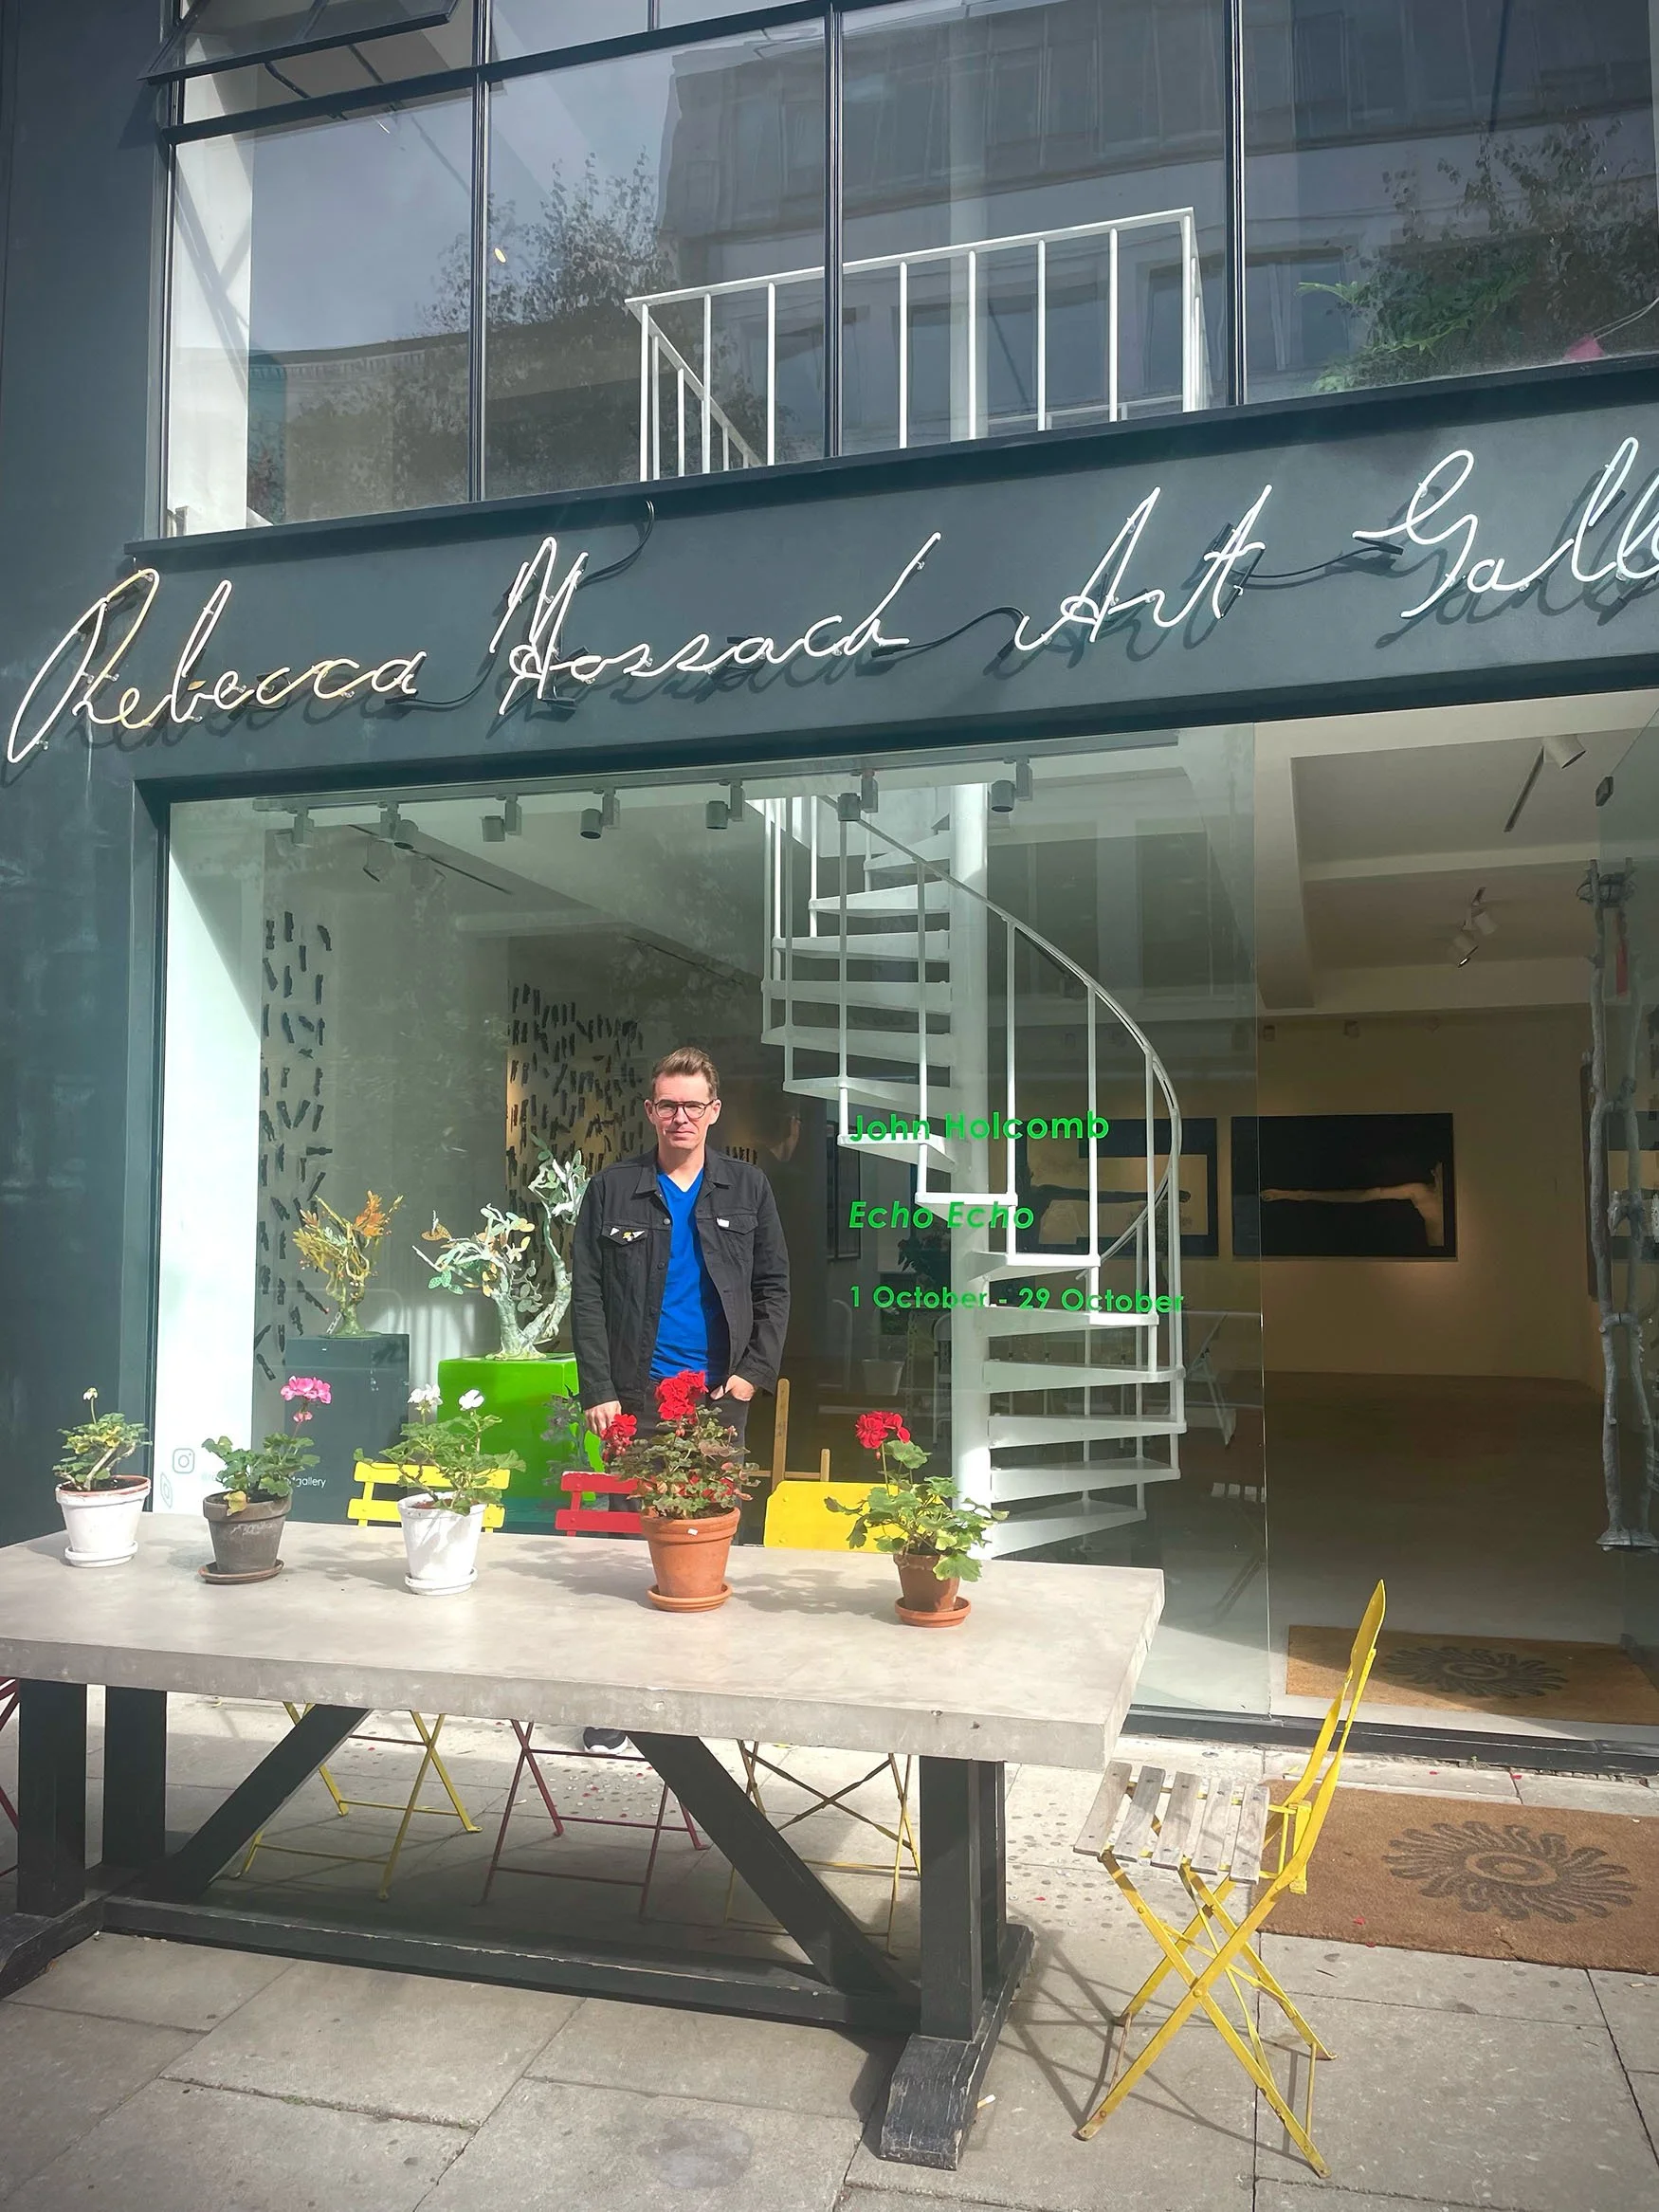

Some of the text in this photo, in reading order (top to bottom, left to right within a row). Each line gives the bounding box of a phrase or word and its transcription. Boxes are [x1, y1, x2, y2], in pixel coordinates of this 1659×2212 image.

[8, 567, 428, 763] Rebecca
[1013, 484, 1273, 650] Art
[1352, 436, 1659, 619] Gall
[849, 1110, 1110, 1142] John Holcomb
[848, 1200, 1034, 1229] Echo Echo
[849, 1285, 862, 1307] 1
[872, 1285, 988, 1309] October
[1018, 1288, 1051, 1310] 29
[1060, 1288, 1185, 1314] October
